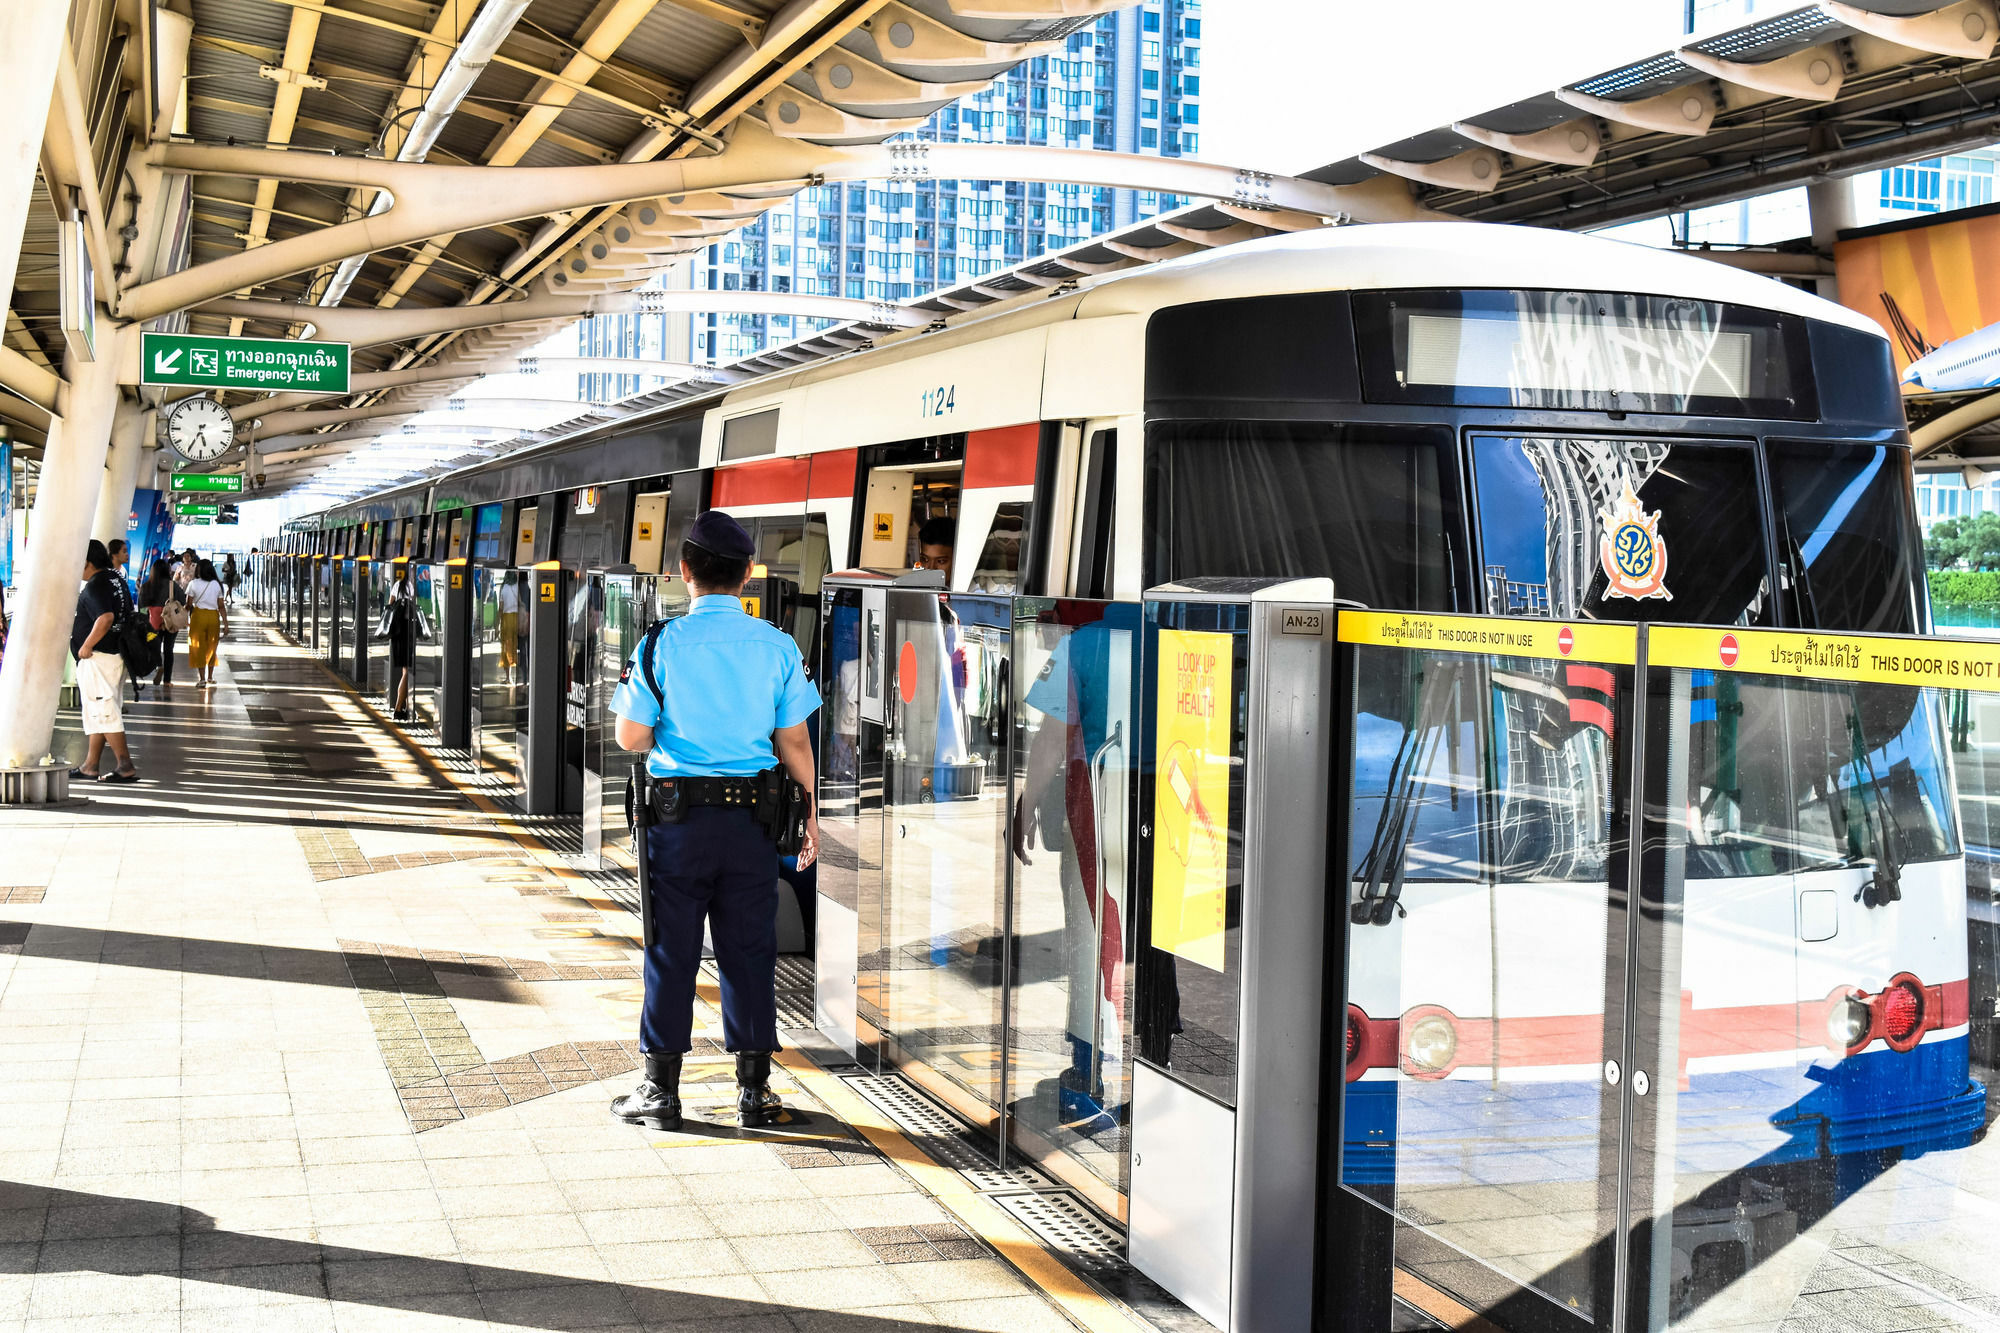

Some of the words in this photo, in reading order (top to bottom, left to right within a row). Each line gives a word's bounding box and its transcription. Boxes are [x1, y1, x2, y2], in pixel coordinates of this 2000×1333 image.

[225, 349, 338, 371] ทางออกฉุกเฉิน
[226, 366, 294, 382] Emergency
[296, 369, 320, 382] Exit
[922, 384, 955, 418] 1124
[1286, 615, 1319, 628] AN-23
[1382, 616, 1433, 643] ประตูนี้ไม่ได้ใช้
[1438, 629, 1454, 641] THIS
[1455, 630, 1478, 643] DOOR
[1479, 631, 1487, 643] IS
[1488, 632, 1505, 645] NOT
[1506, 633, 1515, 645] IN
[1516, 634, 1533, 647] USE
[1177, 652, 1201, 673] LOOK
[1203, 654, 1216, 674] UP
[1770, 637, 1862, 672] ประตูนี้ไม่ได้ใช้
[1871, 655, 1899, 672] THIS
[1903, 657, 1942, 674] DOOR
[1947, 660, 1959, 675] IS
[1963, 661, 1993, 678] NOT
[1177, 672, 1193, 690] FOR
[1194, 674, 1215, 692] YOUR
[1177, 691, 1215, 718] HEALTH
